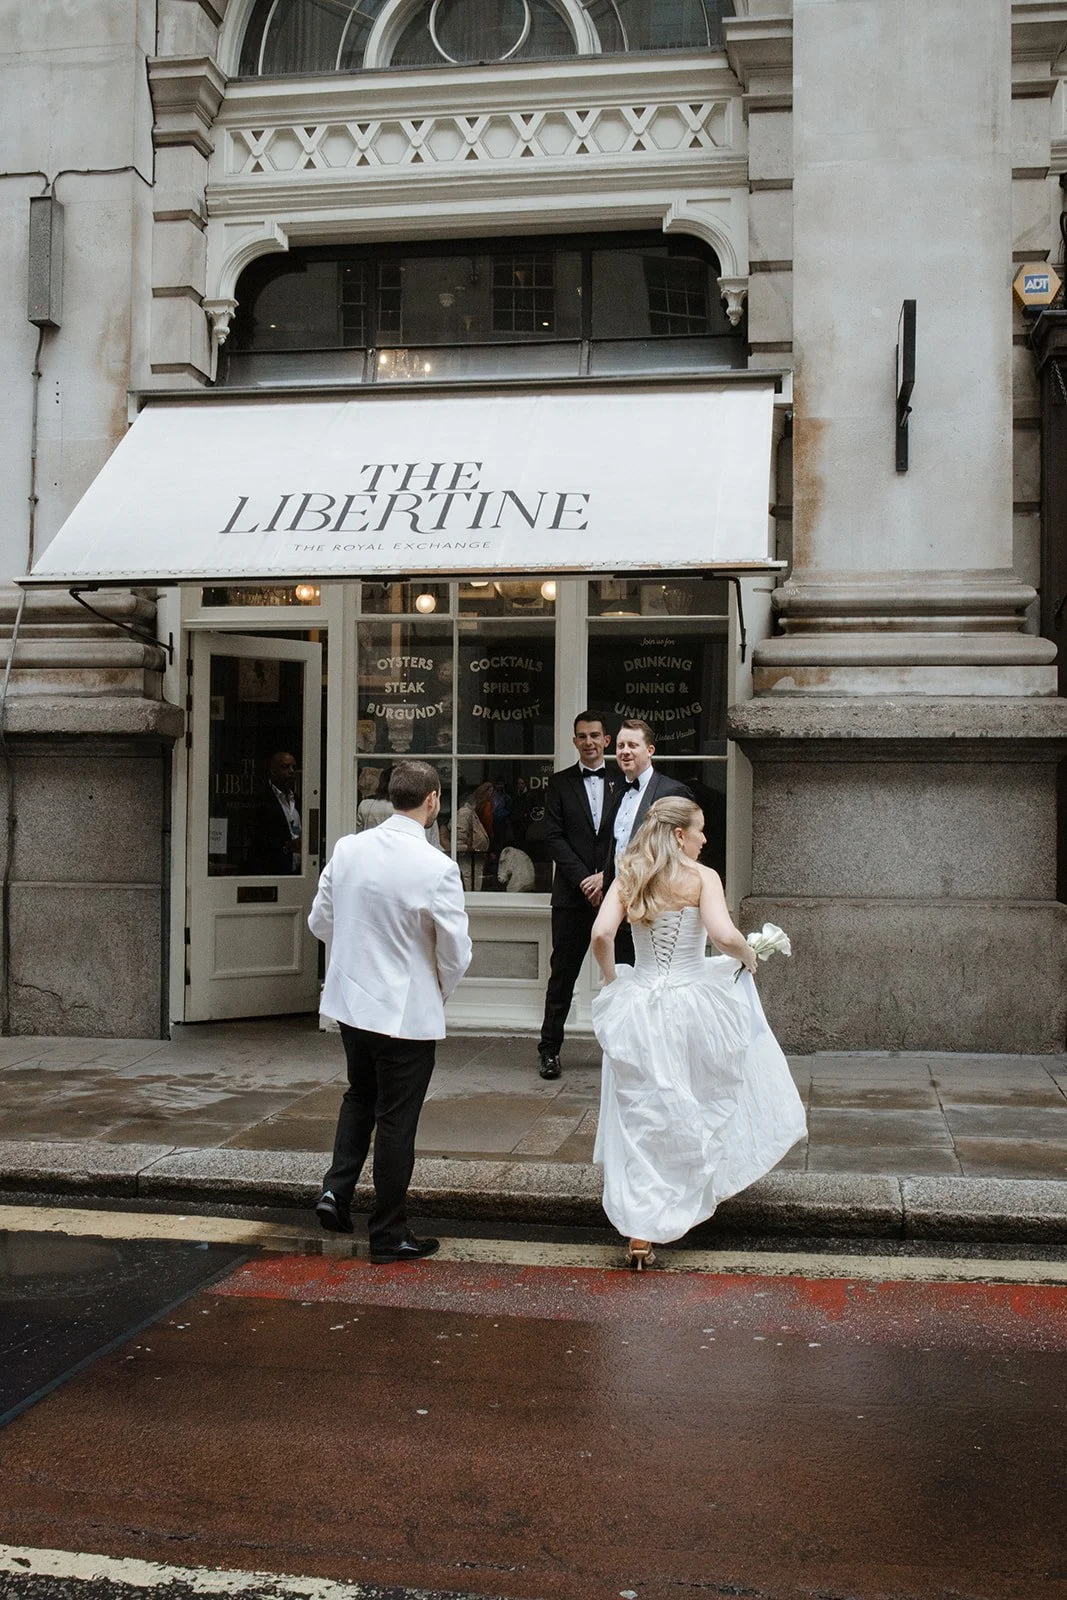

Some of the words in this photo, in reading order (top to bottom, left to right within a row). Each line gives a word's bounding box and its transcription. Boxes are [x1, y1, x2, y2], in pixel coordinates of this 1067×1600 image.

[1025, 279, 1049, 290] ADT
[360, 461, 483, 492] THE
[218, 490, 591, 535] LIBERTINE
[294, 544, 326, 552] THE
[333, 543, 385, 552] ROYAL
[393, 541, 492, 550] EXCHANGE
[376, 656, 434, 670] OYSTERS
[469, 656, 544, 672] COCKTAILS
[623, 656, 693, 672] DRINKING
[384, 682, 425, 694] STEAK
[482, 682, 530, 694] SPIRITS
[626, 682, 675, 694] DINING
[678, 682, 689, 694] &
[366, 702, 444, 720] BURGUNDY
[472, 704, 541, 721] DRAUGHT
[614, 702, 703, 722] UNWINDING
